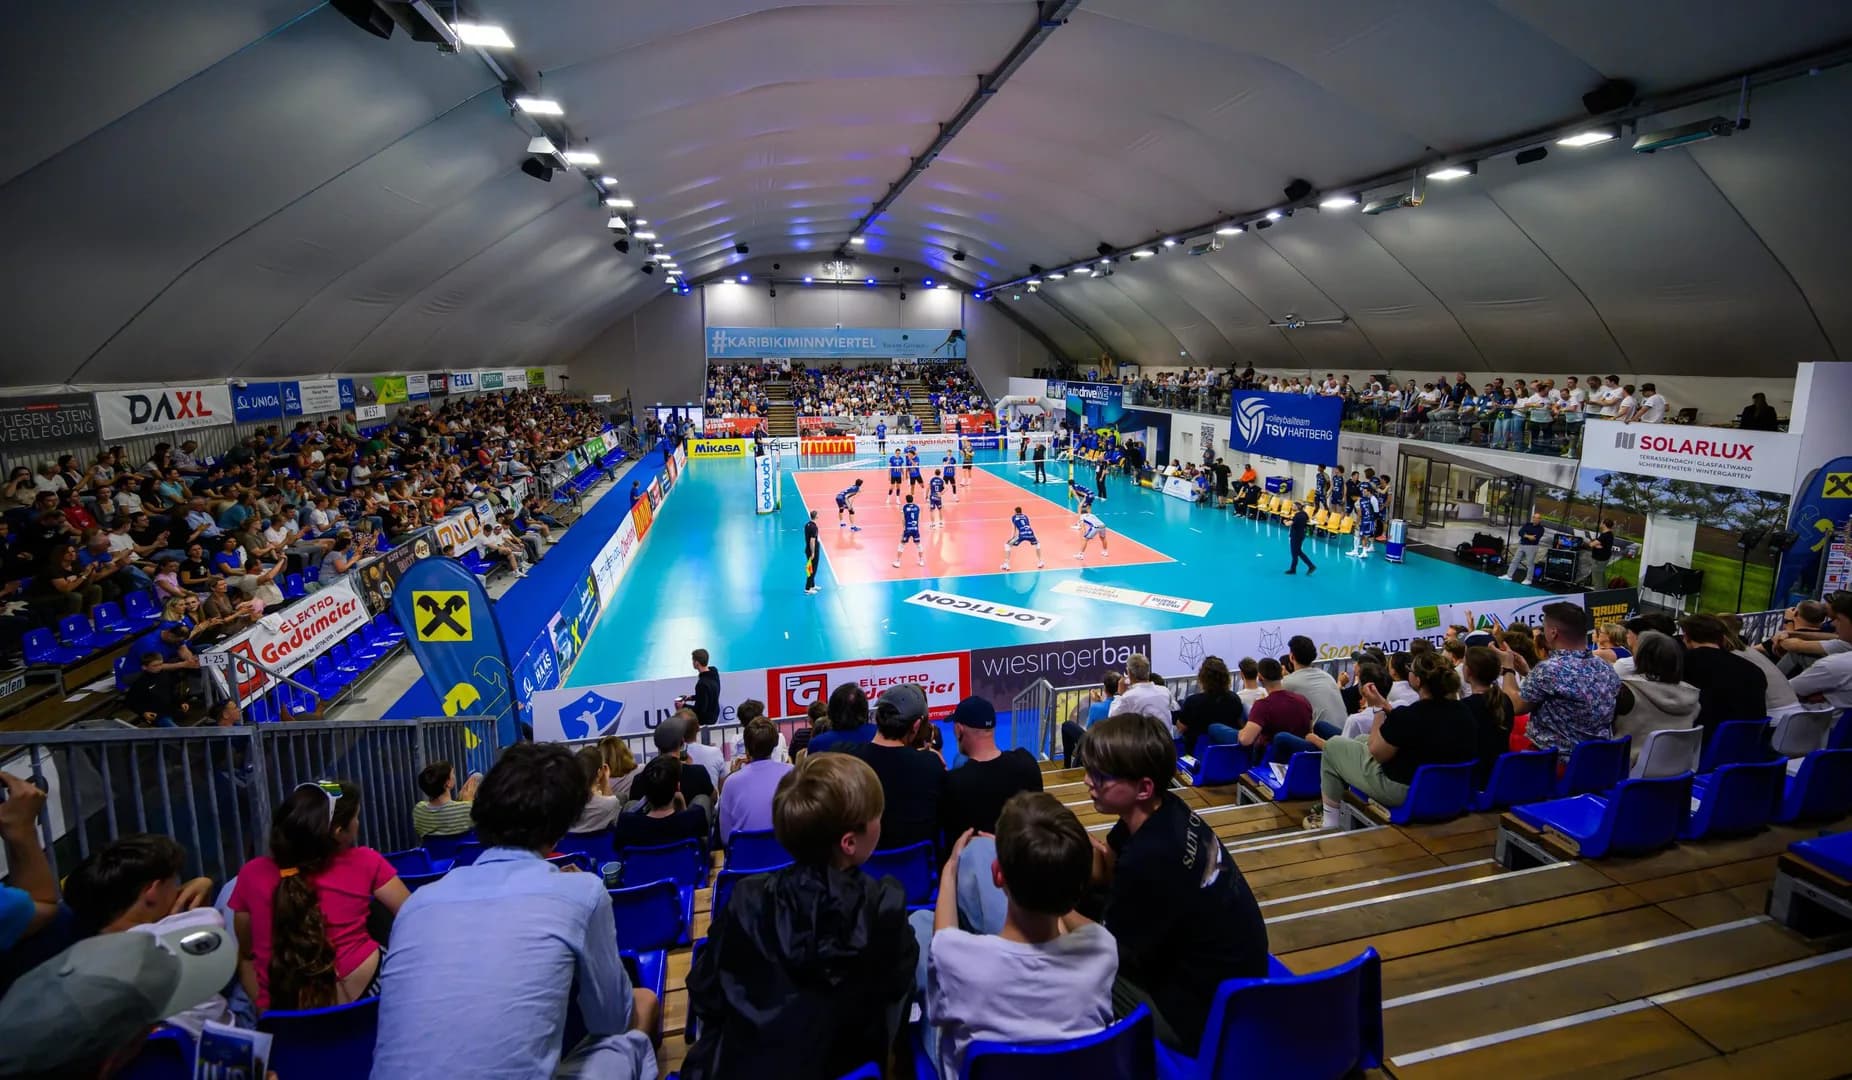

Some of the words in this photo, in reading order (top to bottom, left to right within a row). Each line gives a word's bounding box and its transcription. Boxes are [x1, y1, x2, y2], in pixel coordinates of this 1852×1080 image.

[122, 390, 213, 425] DAXL
[251, 395, 280, 408] UNIQA
[0, 412, 50, 429] LIESEN
[55, 409, 93, 423] STEIN
[363, 406, 379, 417] WEST
[1265, 415, 1311, 427] volleyballteam
[0, 421, 95, 443] VERLEGUNG
[1265, 423, 1288, 439] TSV
[1287, 428, 1334, 441] HARTBERG
[1639, 434, 1756, 461] SOLARLUX
[1695, 467, 1752, 480] WINTERGARTEN
[1696, 460, 1754, 472] GLASFALTWAND
[279, 595, 335, 634] ELEKTRO
[917, 593, 1052, 627] LOCTICON
[260, 598, 357, 665] Gadermeier
[203, 654, 225, 665] 1-25
[859, 673, 930, 688] ELEKTRO
